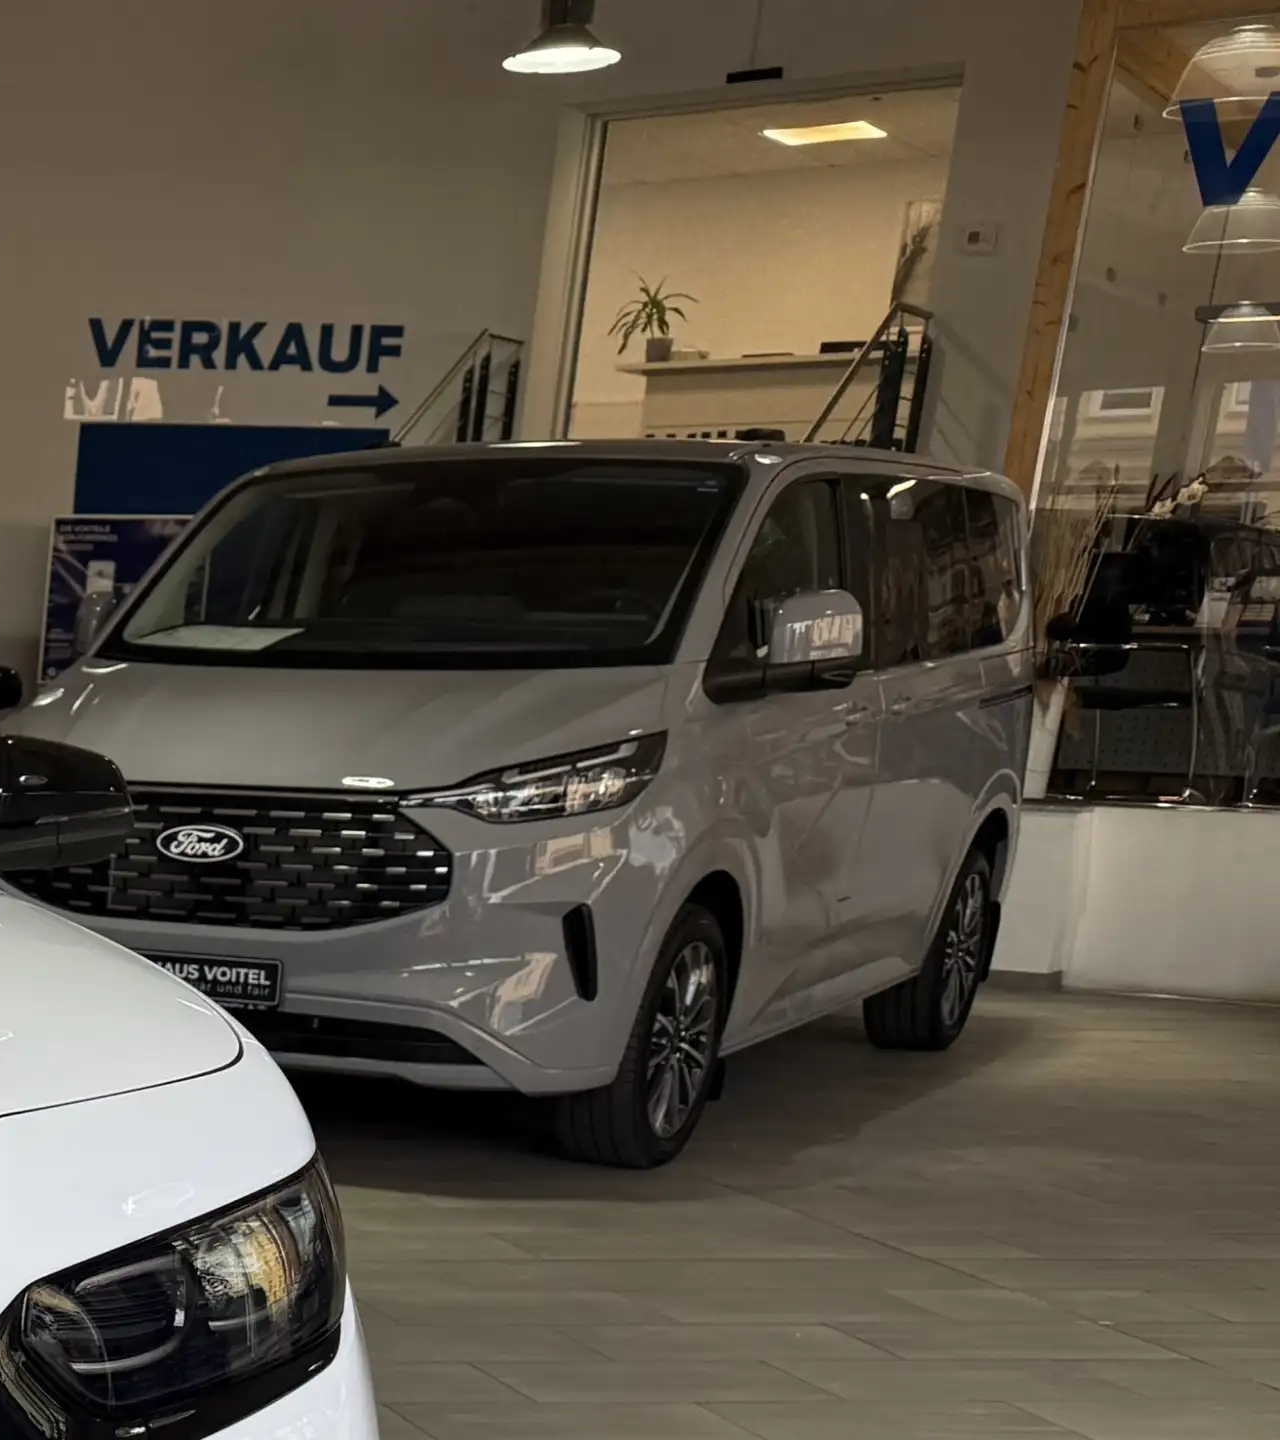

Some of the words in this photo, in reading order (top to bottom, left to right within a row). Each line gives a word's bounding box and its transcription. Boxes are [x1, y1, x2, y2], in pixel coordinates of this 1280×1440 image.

[88, 317, 405, 374] VERKAUF
[169, 829, 229, 857] Ford
[203, 965, 271, 986] VOITEL
[216, 983, 242, 995] und
[247, 984, 270, 997] fair
